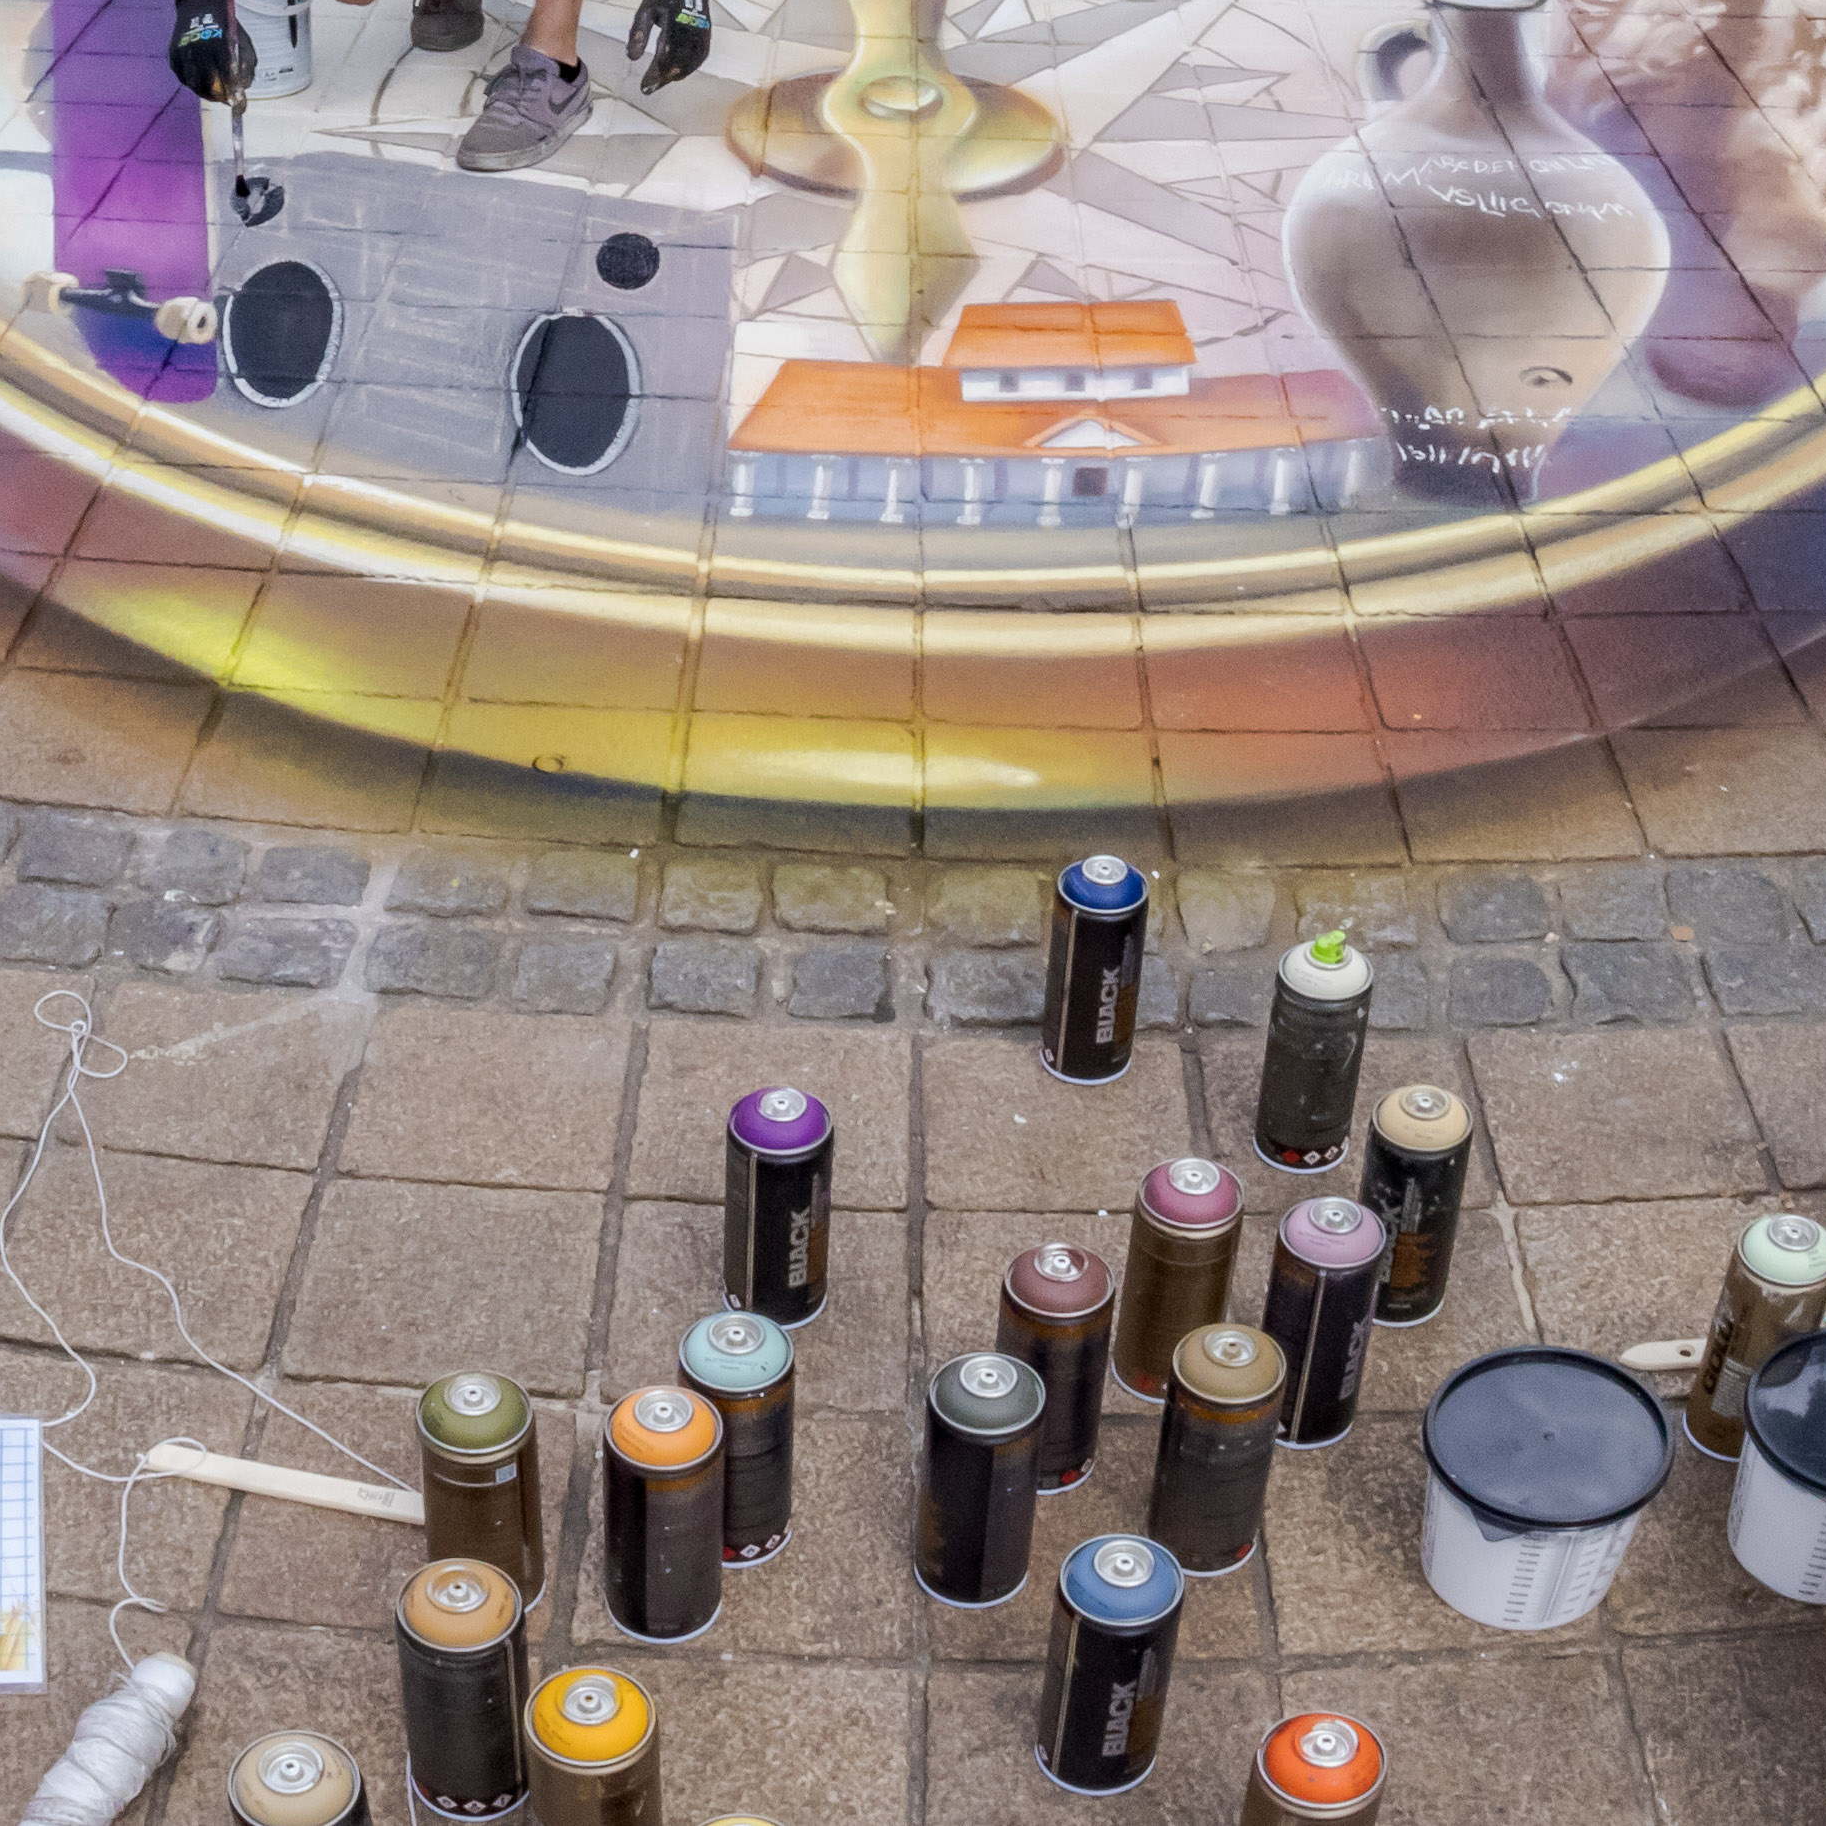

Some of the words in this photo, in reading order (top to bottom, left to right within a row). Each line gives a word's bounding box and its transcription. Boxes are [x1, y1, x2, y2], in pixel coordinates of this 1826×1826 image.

[1096, 965, 1122, 1044] BLACK
[788, 1205, 811, 1289] BLACK
[1102, 1678, 1138, 1758] BLACK
